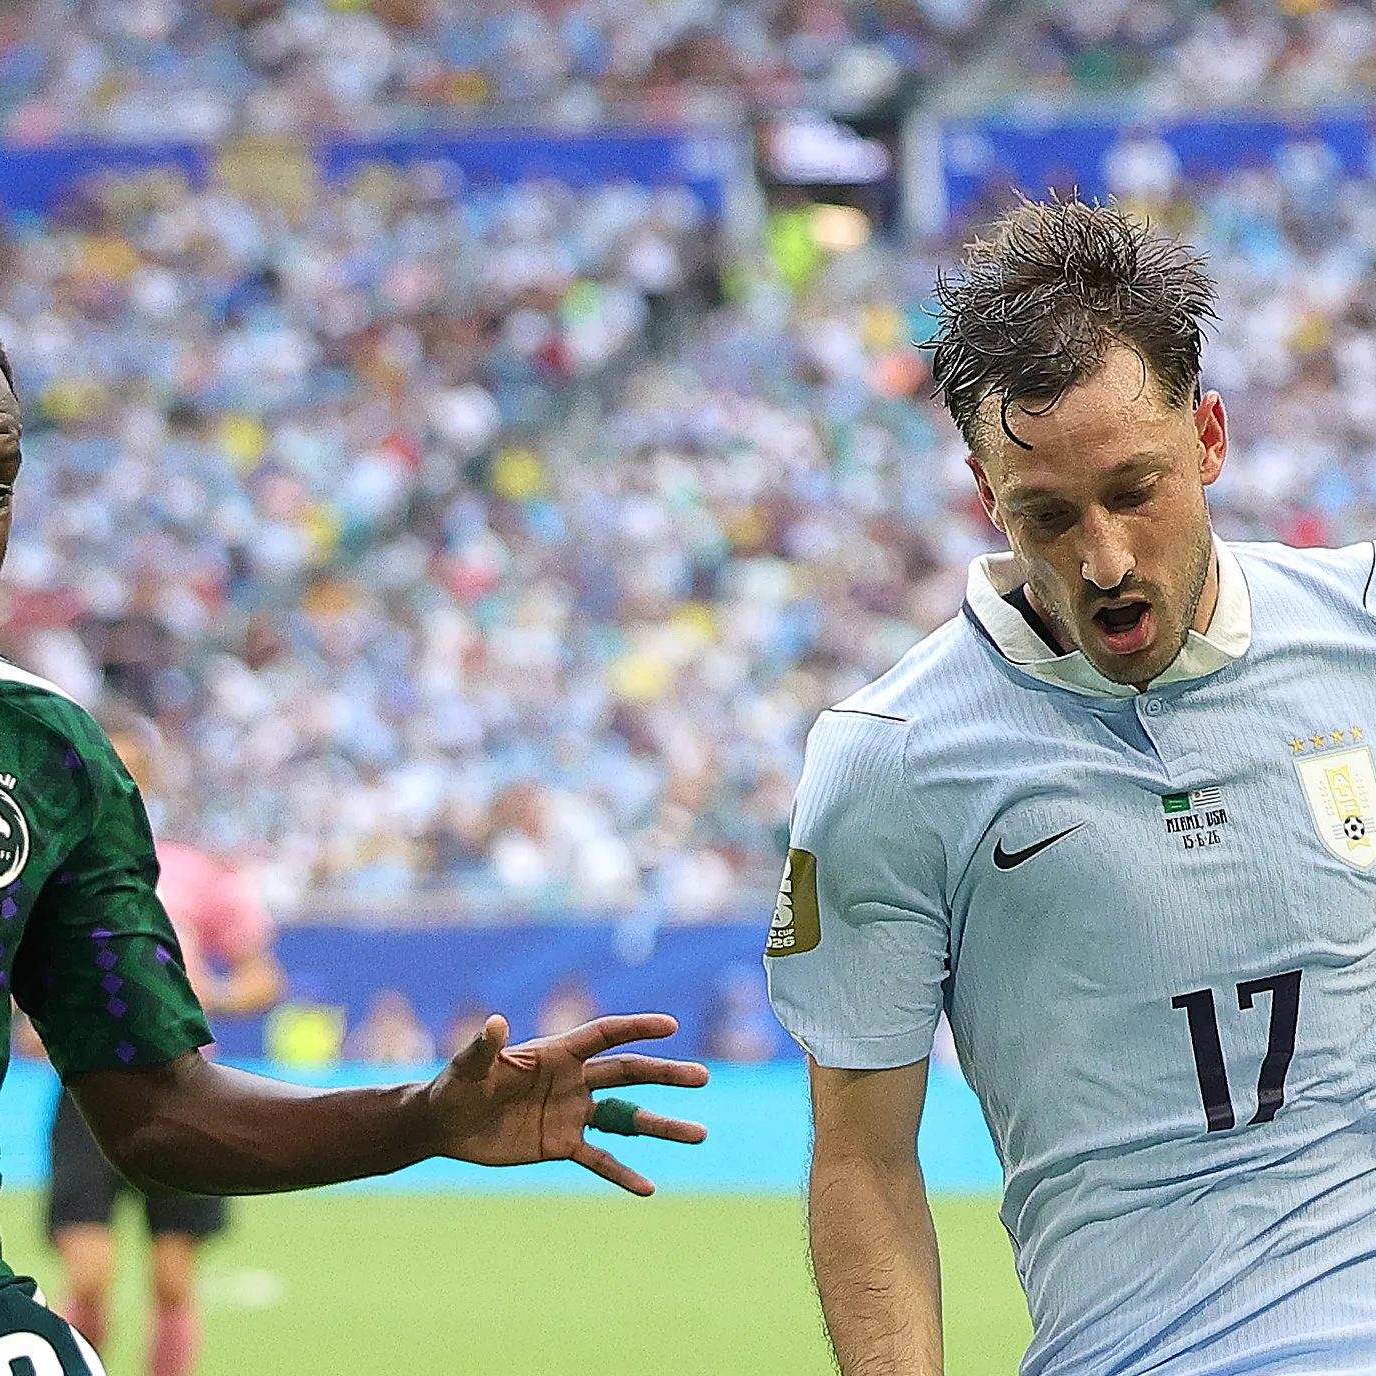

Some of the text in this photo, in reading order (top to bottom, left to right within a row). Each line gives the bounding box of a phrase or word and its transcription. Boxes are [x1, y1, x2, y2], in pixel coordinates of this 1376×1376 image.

[1205, 809, 1228, 827] USA
[766, 937, 795, 949] 26
[1172, 970, 1302, 1133] 17
